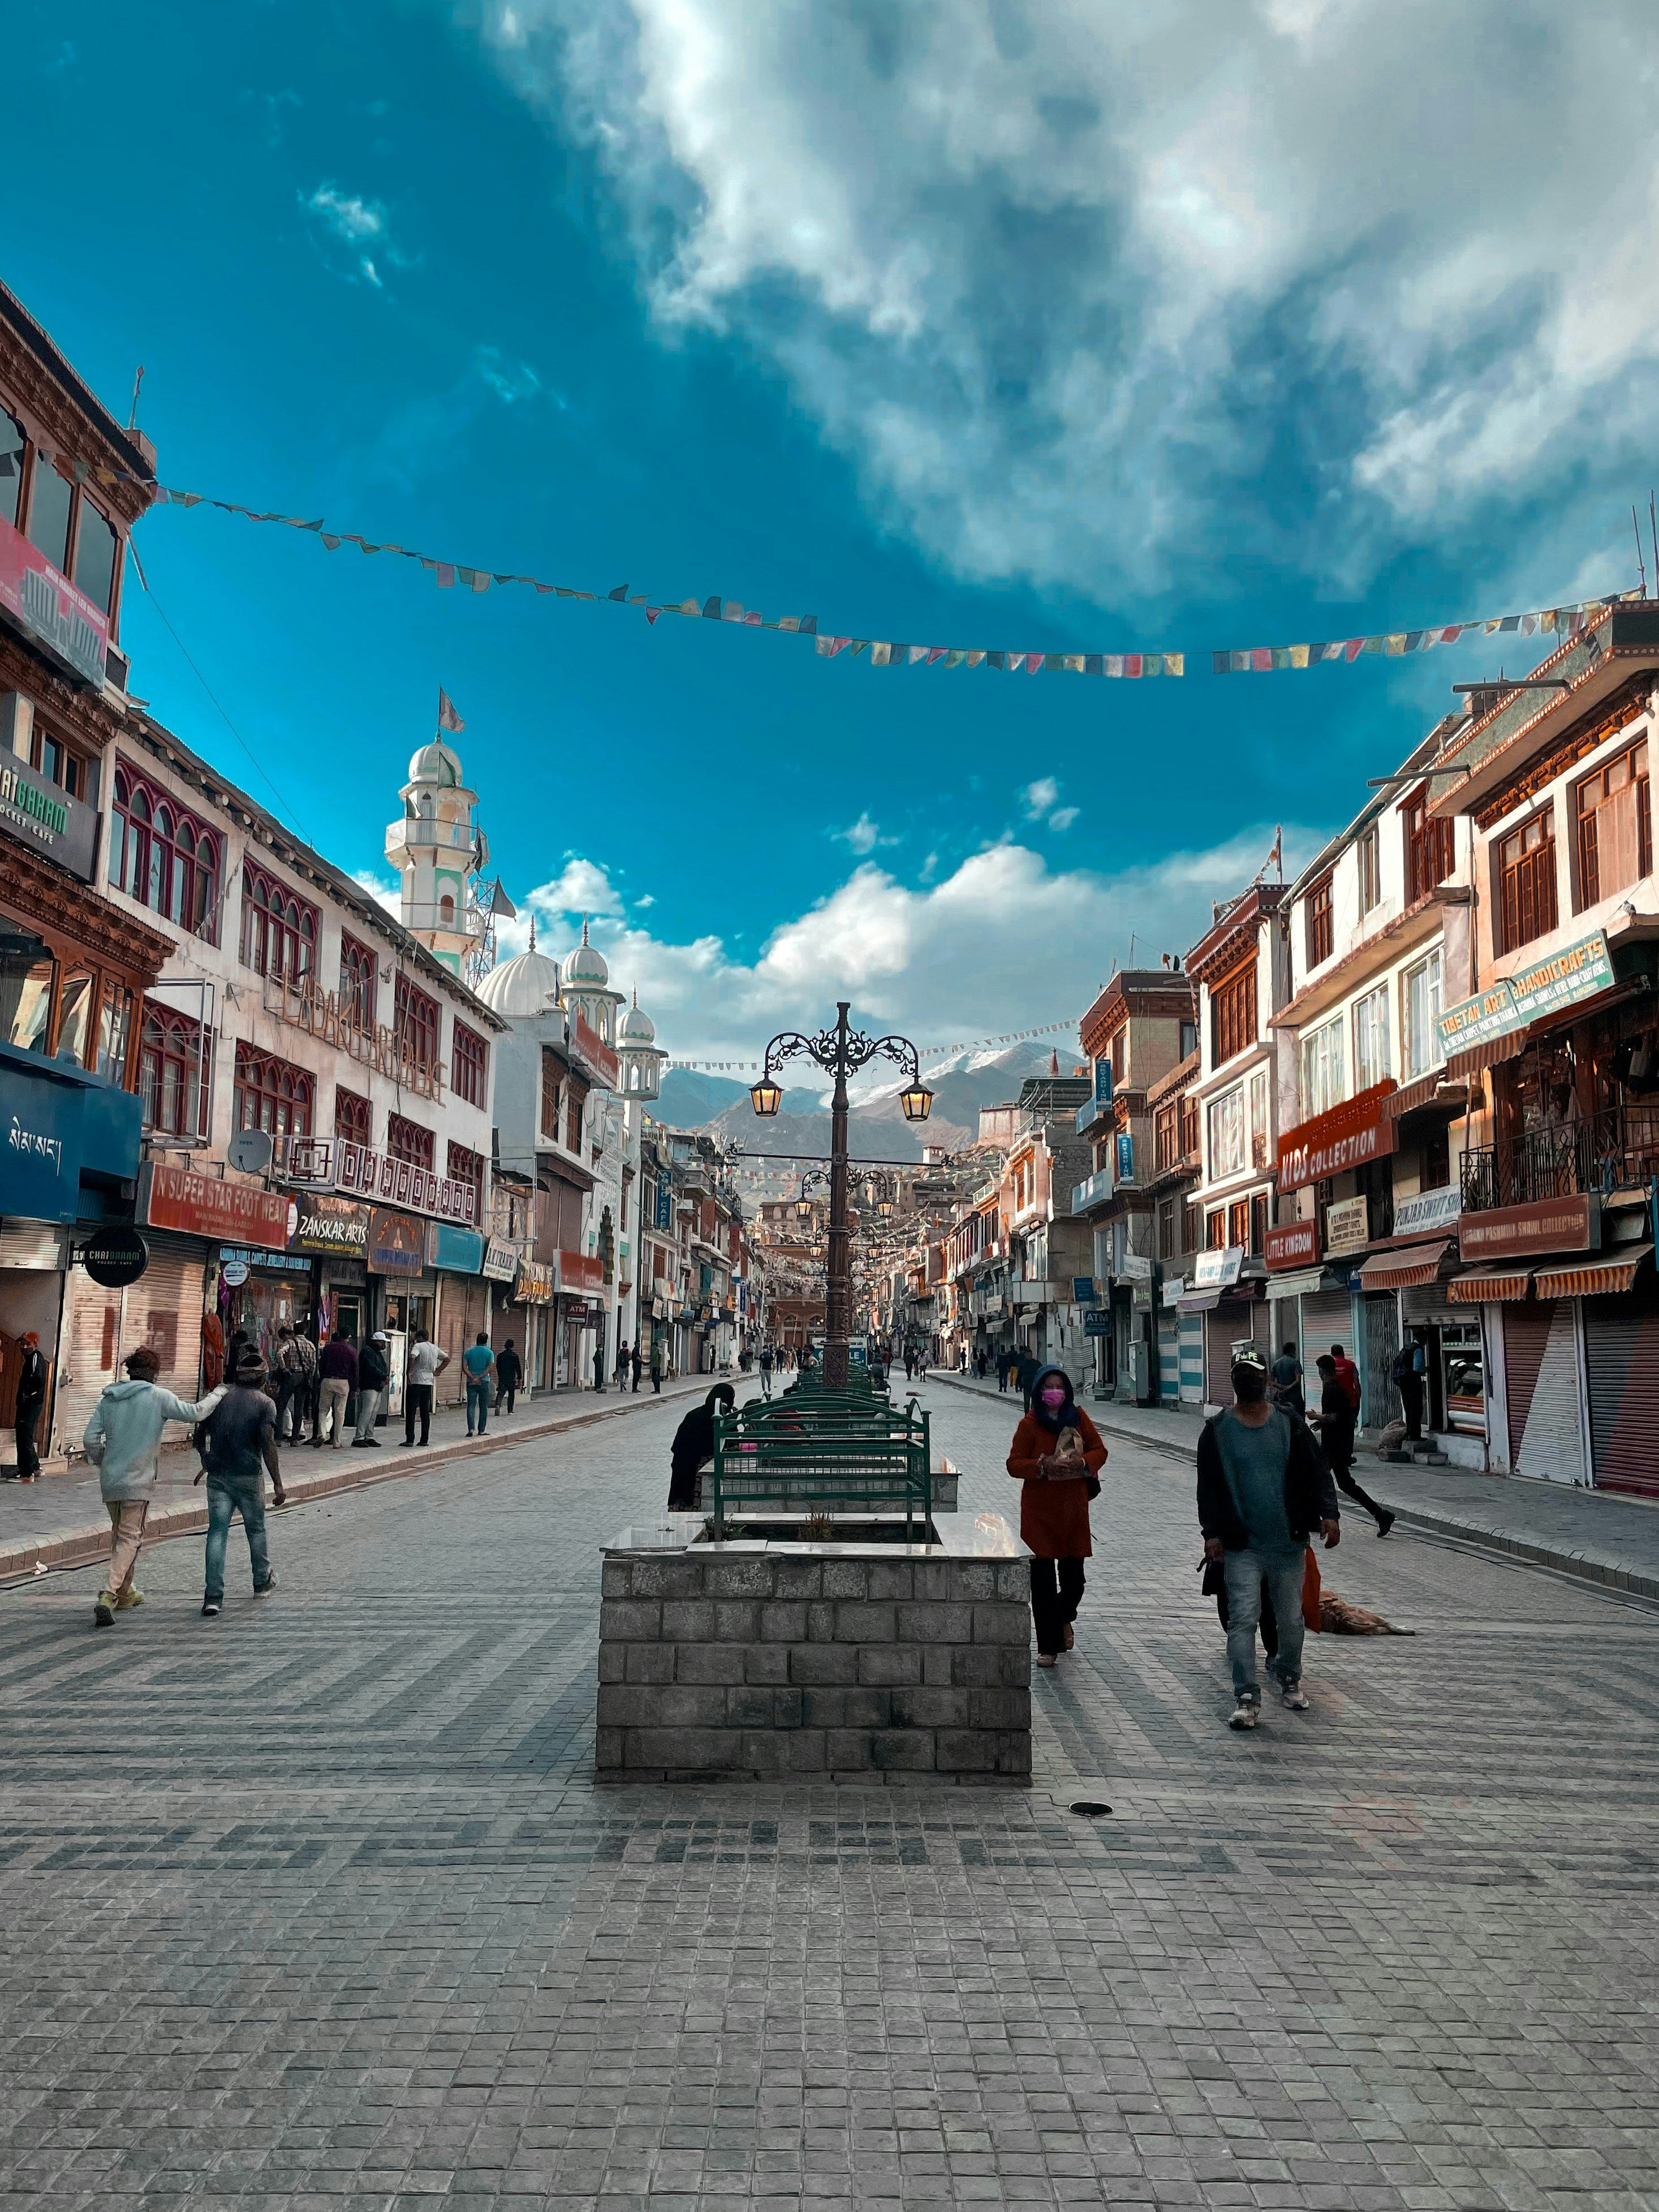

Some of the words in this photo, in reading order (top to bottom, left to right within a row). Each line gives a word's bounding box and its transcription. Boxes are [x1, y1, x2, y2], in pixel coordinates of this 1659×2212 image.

[0, 767, 67, 835] AIGARAM
[32, 825, 54, 845] CAFE
[1439, 1004, 1481, 1036] TIBETAN
[1484, 989, 1507, 1015] ART
[1516, 937, 1604, 997] HANDICRAFTS
[1281, 1143, 1308, 1188] KIDS
[1310, 1126, 1376, 1177] COLLECTION
[169, 1173, 205, 1206] SUPER
[207, 1181, 231, 1212] STAR
[234, 1189, 261, 1219] FOOT
[1395, 1202, 1423, 1227] PUNJAB
[1518, 1219, 1541, 1236] SHAWL
[299, 1215, 344, 1242] ZANSKAR
[344, 1223, 367, 1244] ARTS
[1267, 1237, 1284, 1260] LITTLE
[1285, 1231, 1312, 1256] KINGDOM
[1087, 1313, 1109, 1323] ATM
